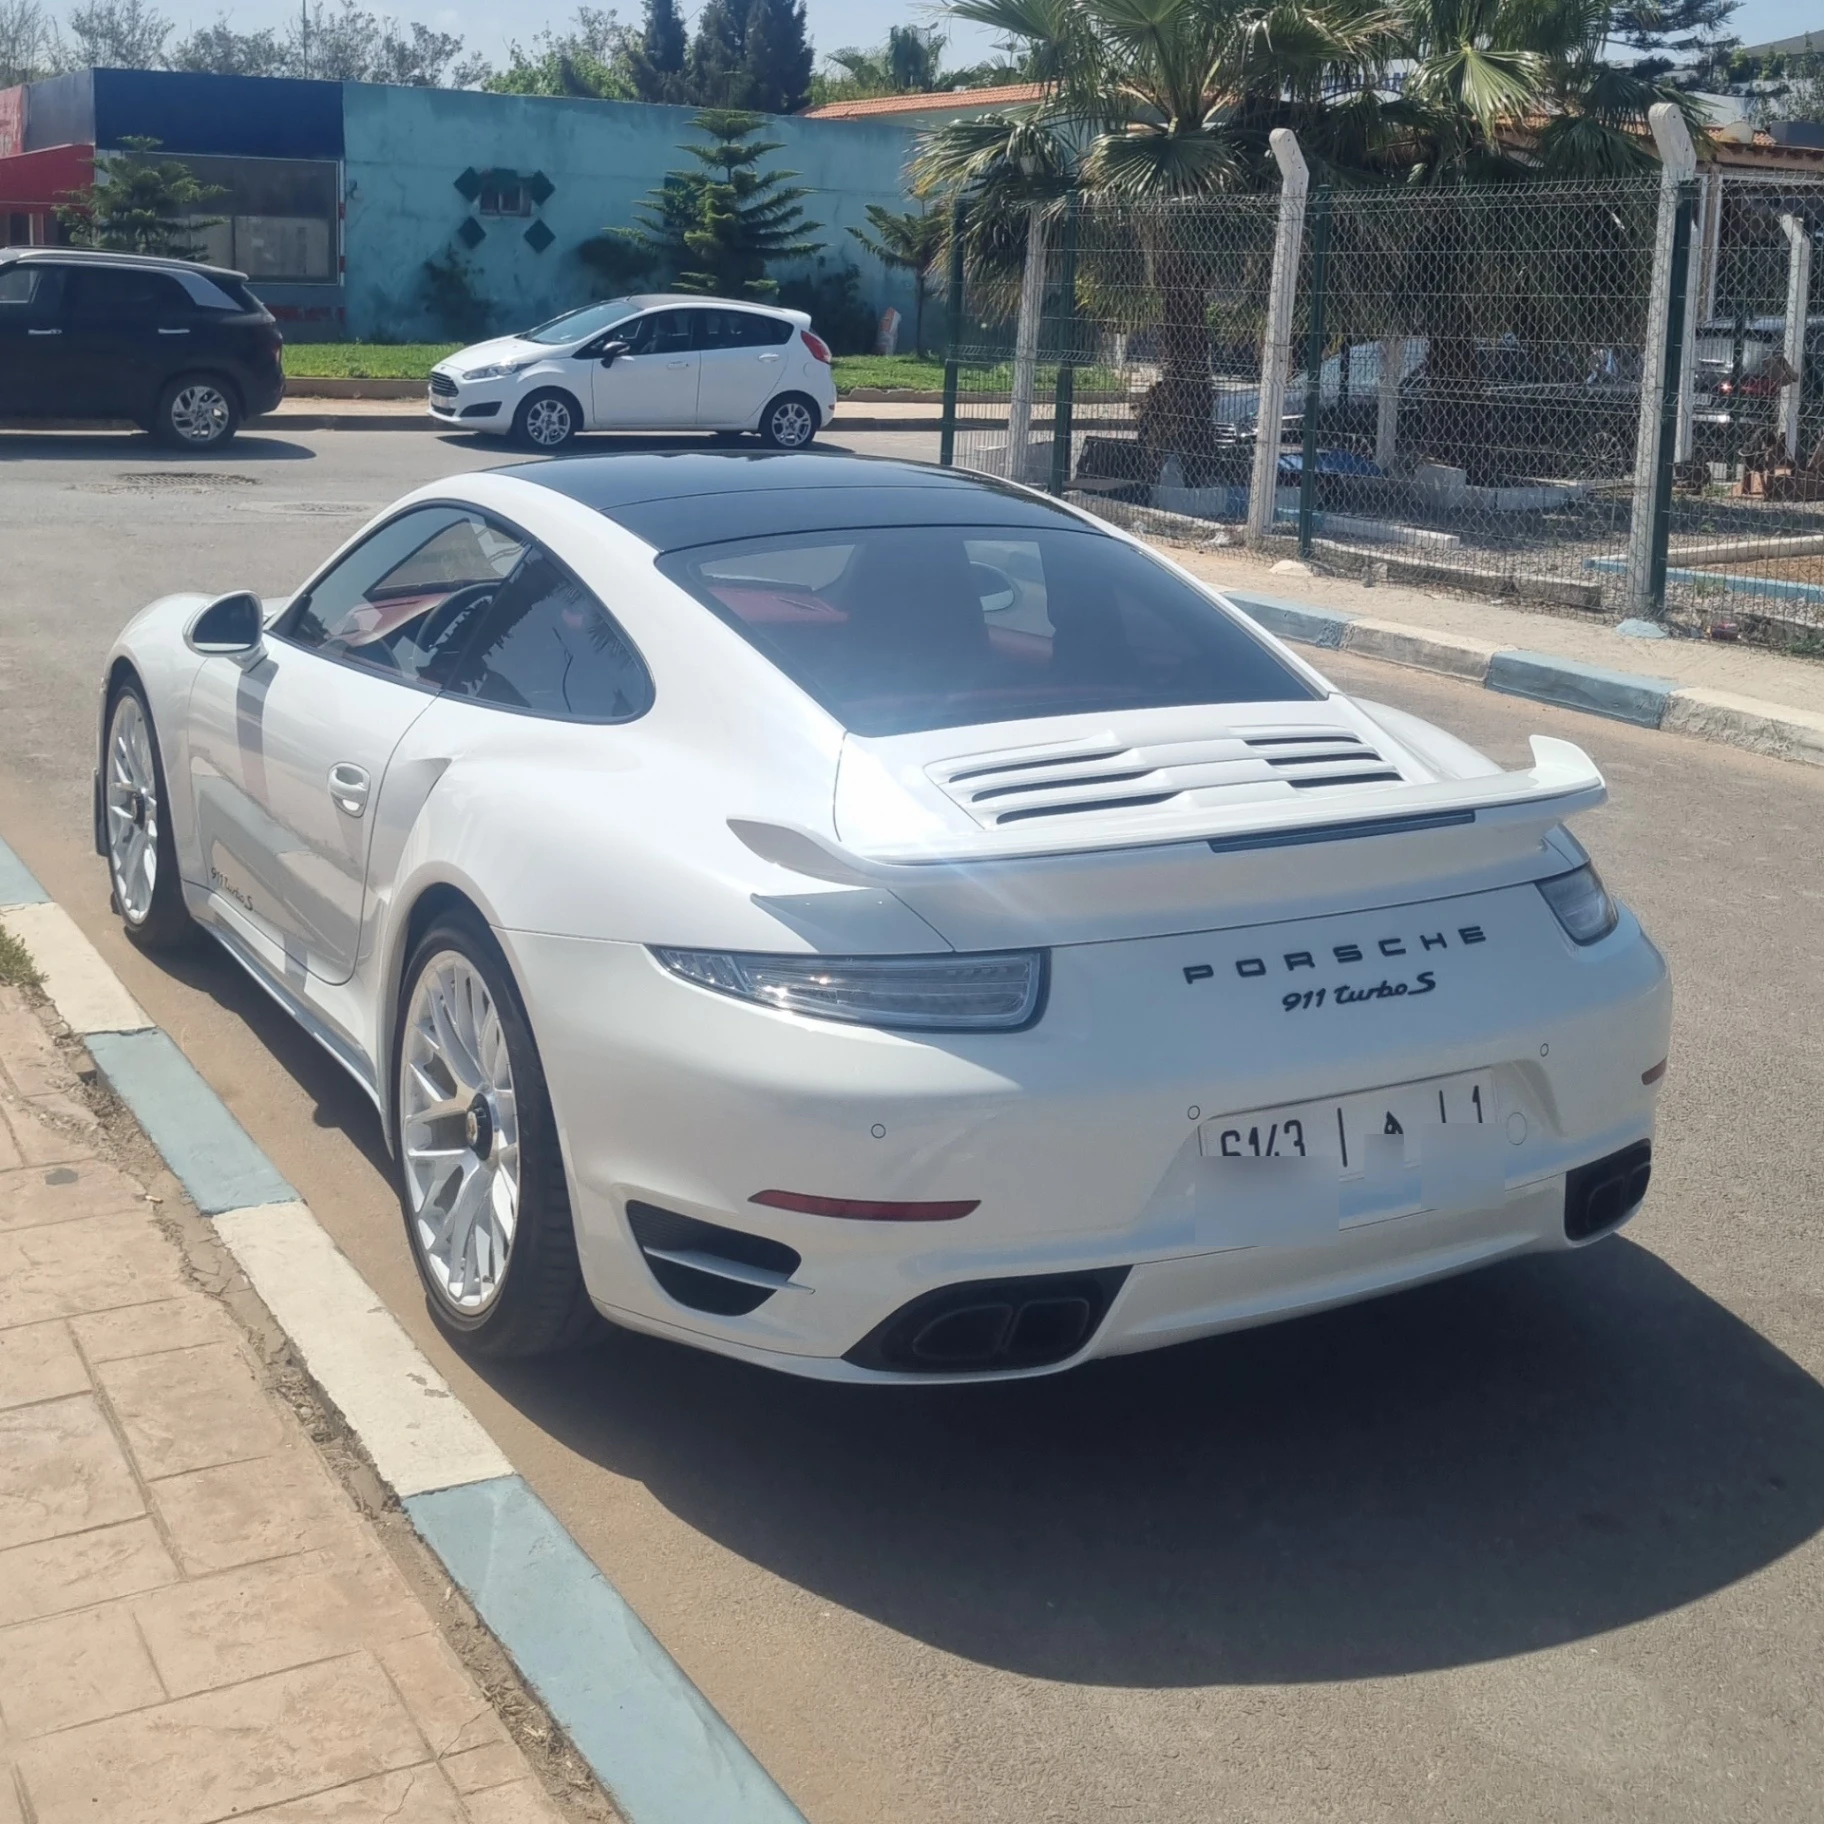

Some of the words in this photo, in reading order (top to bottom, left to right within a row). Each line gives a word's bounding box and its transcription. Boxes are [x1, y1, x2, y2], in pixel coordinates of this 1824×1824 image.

[1183, 925, 1487, 984] PORSCHE
[1281, 988, 1326, 1012] 911
[1334, 980, 1408, 1004] turbo
[1407, 971, 1436, 995] S
